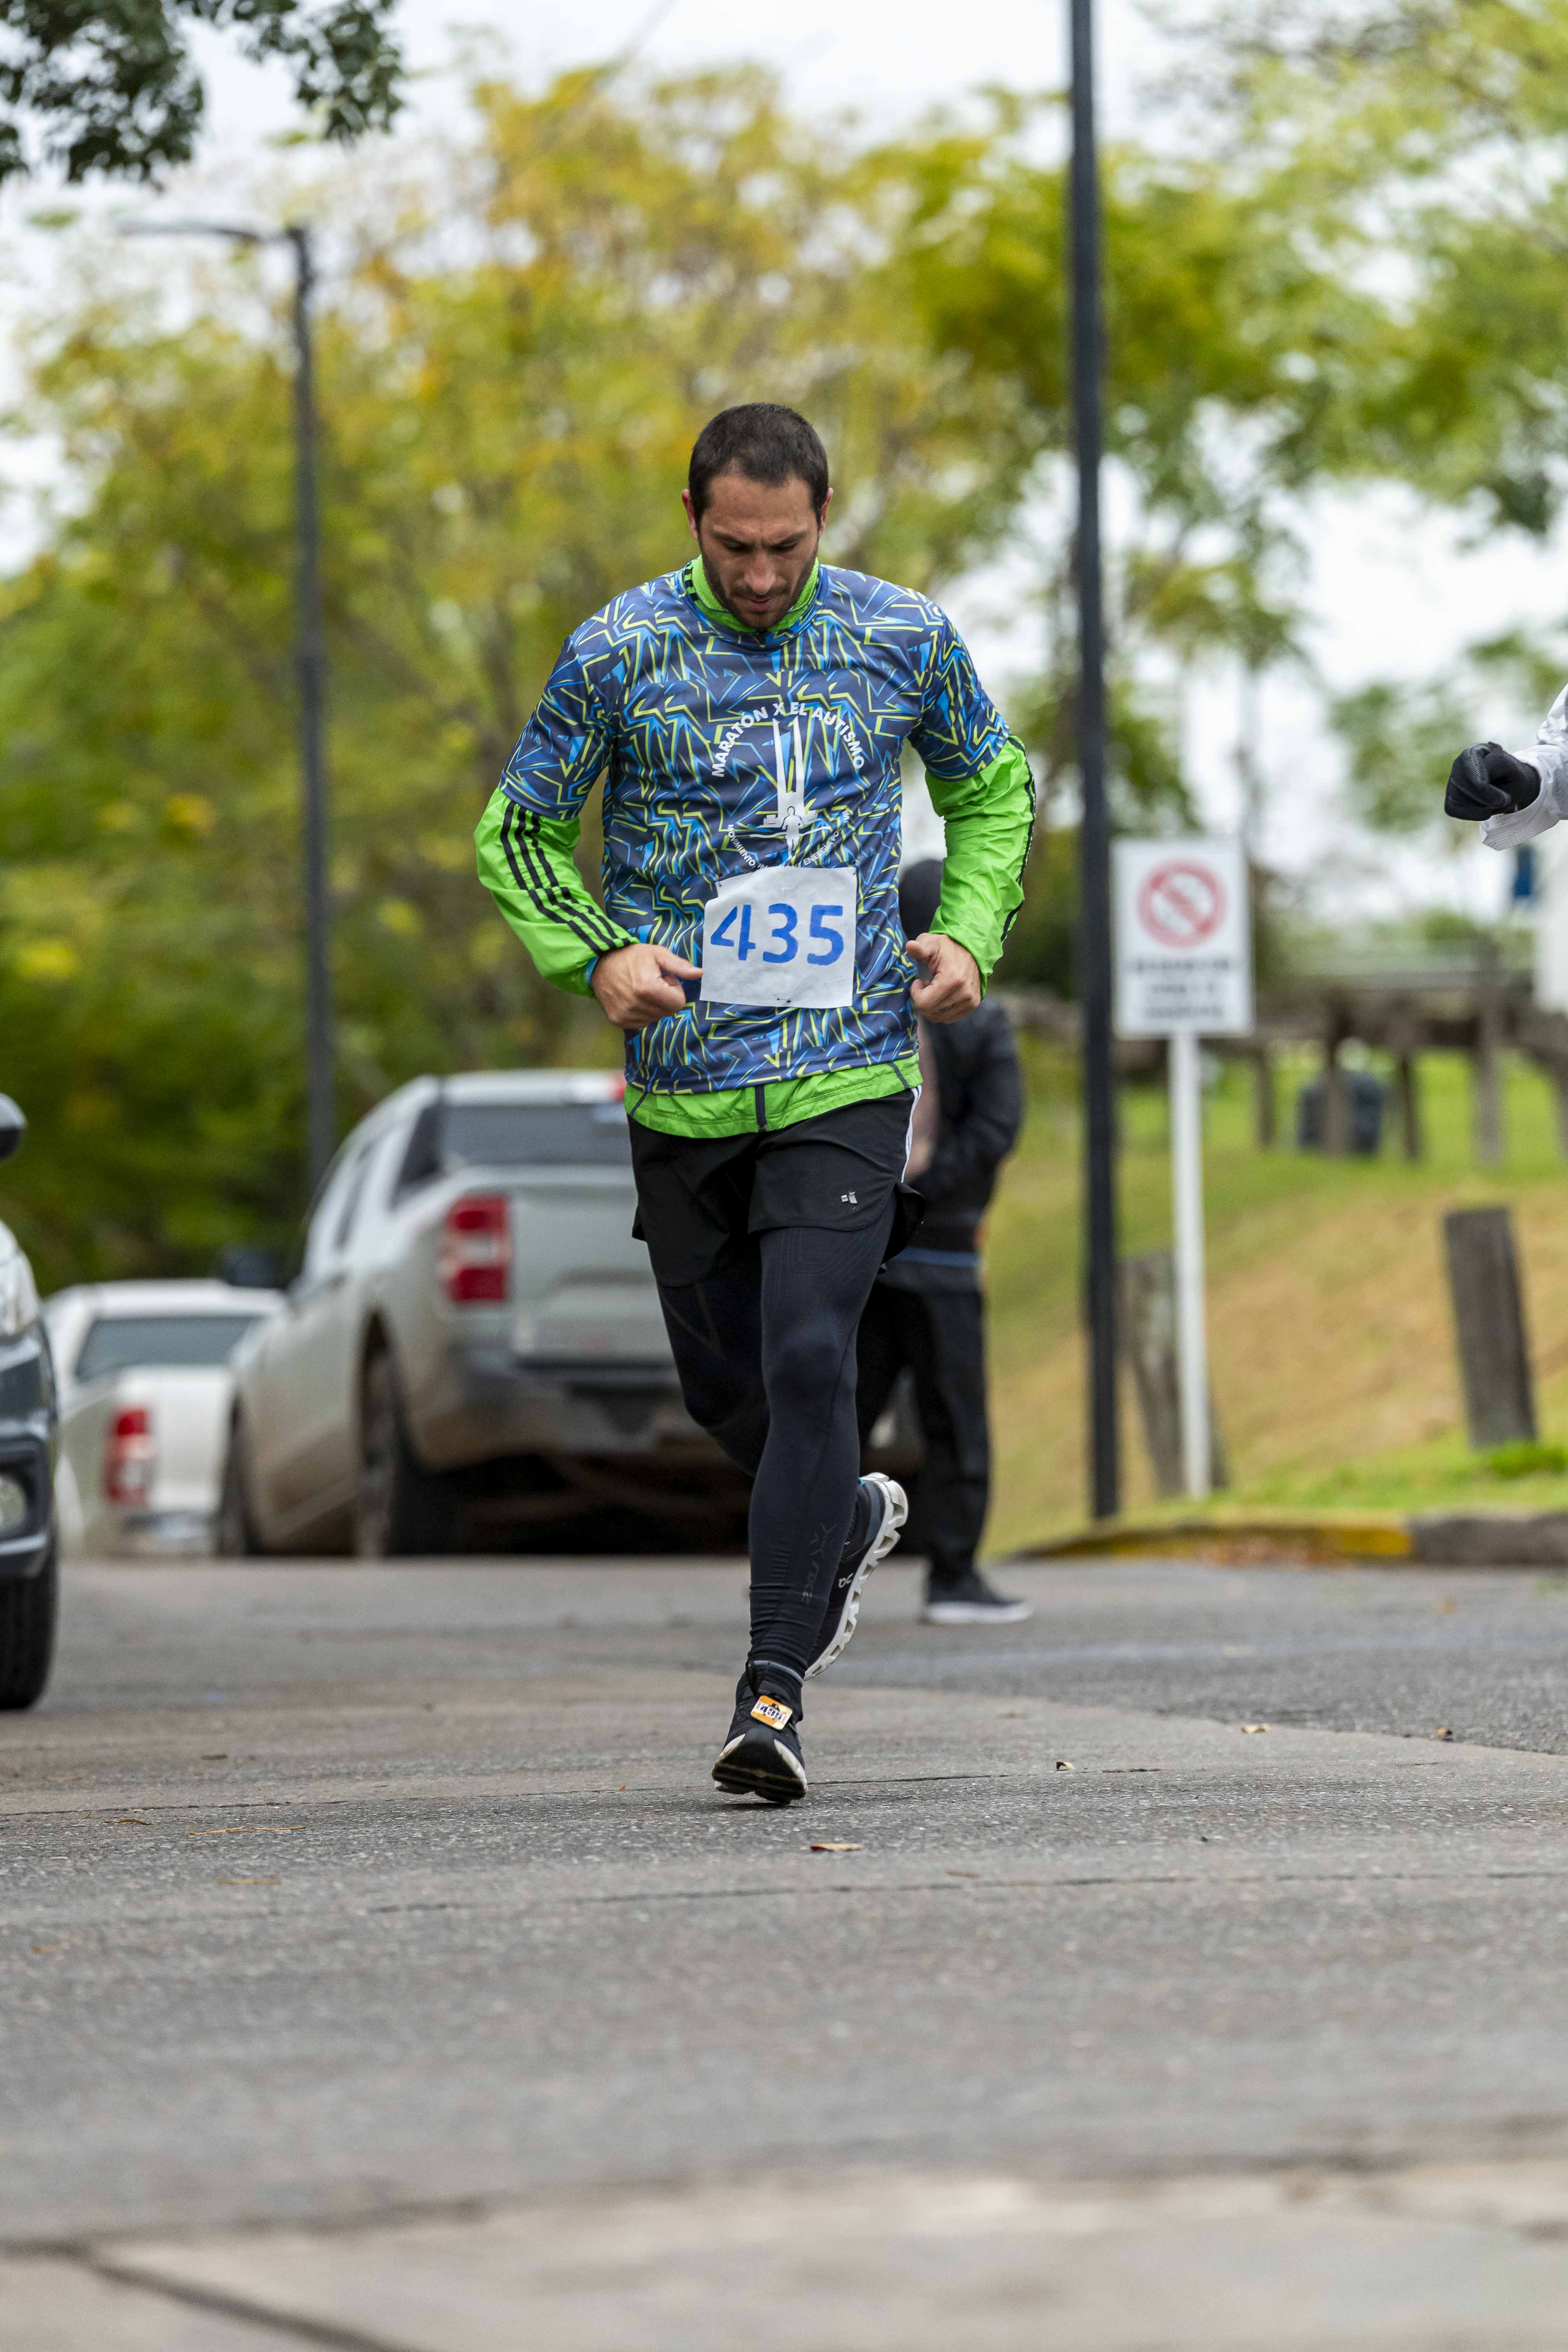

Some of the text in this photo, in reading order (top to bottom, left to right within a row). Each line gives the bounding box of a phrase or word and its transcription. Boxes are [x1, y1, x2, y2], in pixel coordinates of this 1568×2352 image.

[711, 702, 865, 777] MARATÓN X EL AUTISMO
[710, 903, 844, 966] 435
